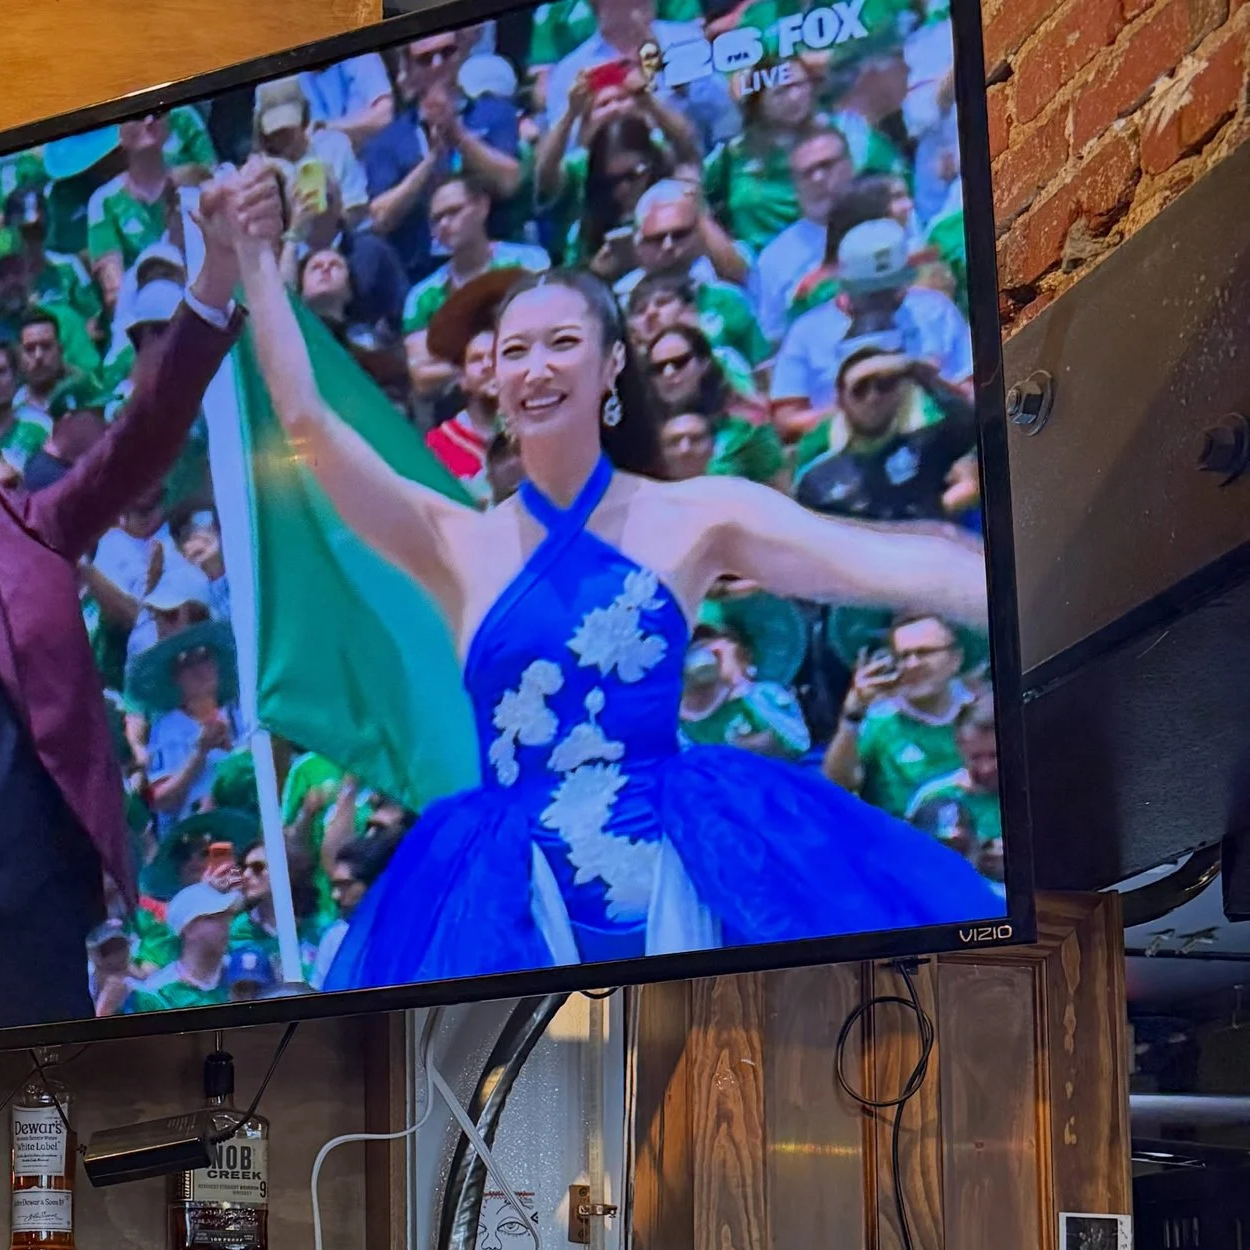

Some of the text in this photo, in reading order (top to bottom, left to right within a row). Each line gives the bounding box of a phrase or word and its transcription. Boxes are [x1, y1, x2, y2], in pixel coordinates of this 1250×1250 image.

[778, 0, 869, 58] FOX
[738, 61, 793, 97] LIVE
[959, 924, 1013, 943] VIZIO
[14, 1120, 63, 1136] Dewar's
[36, 1141, 58, 1151] Label
[207, 1169, 262, 1181] CREEK
[259, 1180, 267, 1199] 9
